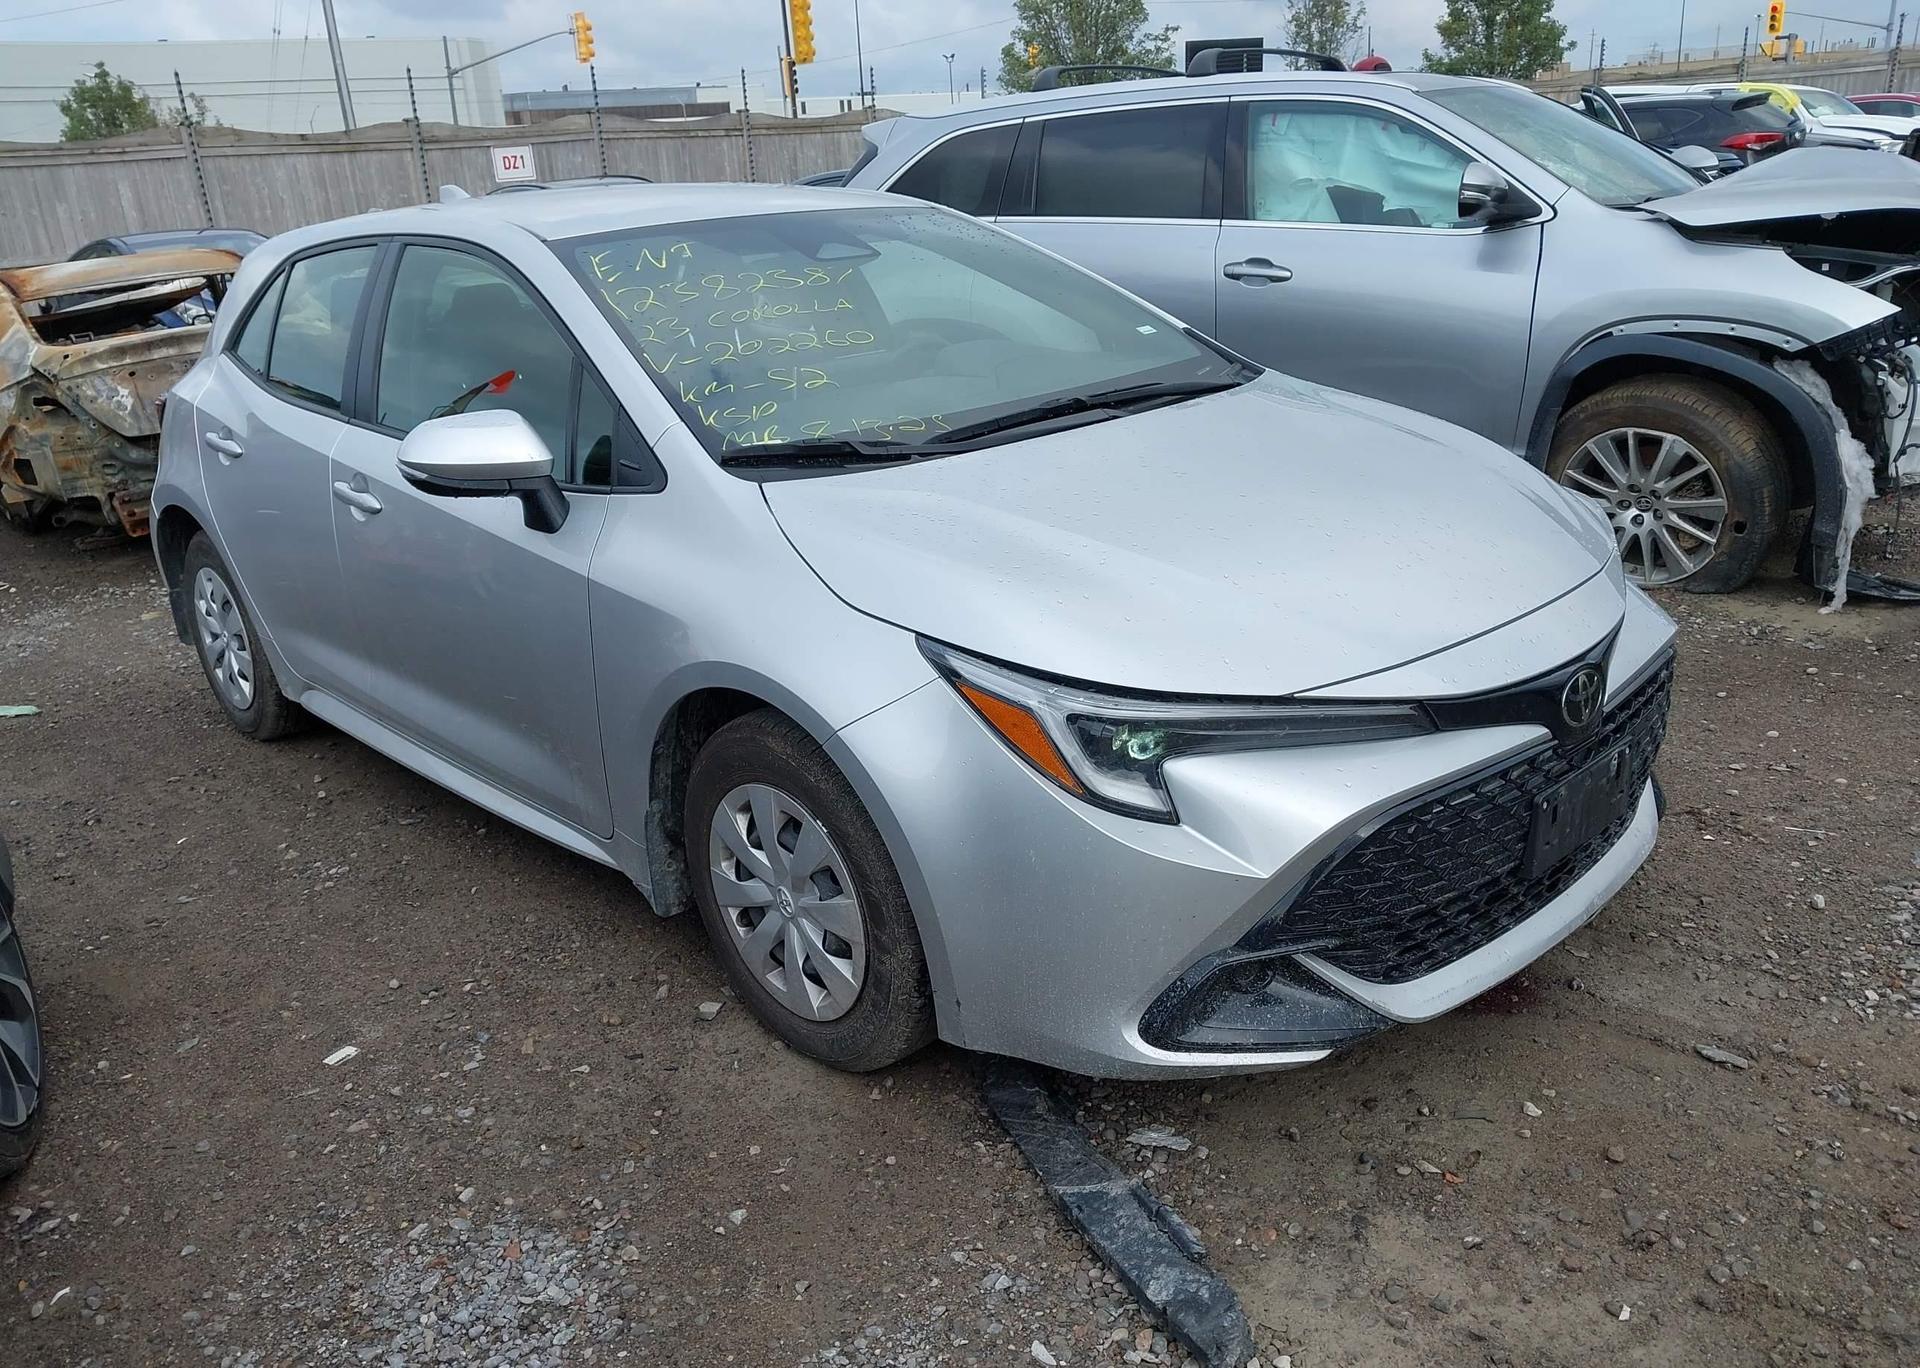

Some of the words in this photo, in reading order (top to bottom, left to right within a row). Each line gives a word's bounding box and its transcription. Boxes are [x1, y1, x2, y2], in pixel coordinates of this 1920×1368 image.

[503, 155, 525, 170] DZ1
[640, 317, 690, 345] 23
[708, 298, 855, 327] COROLLA
